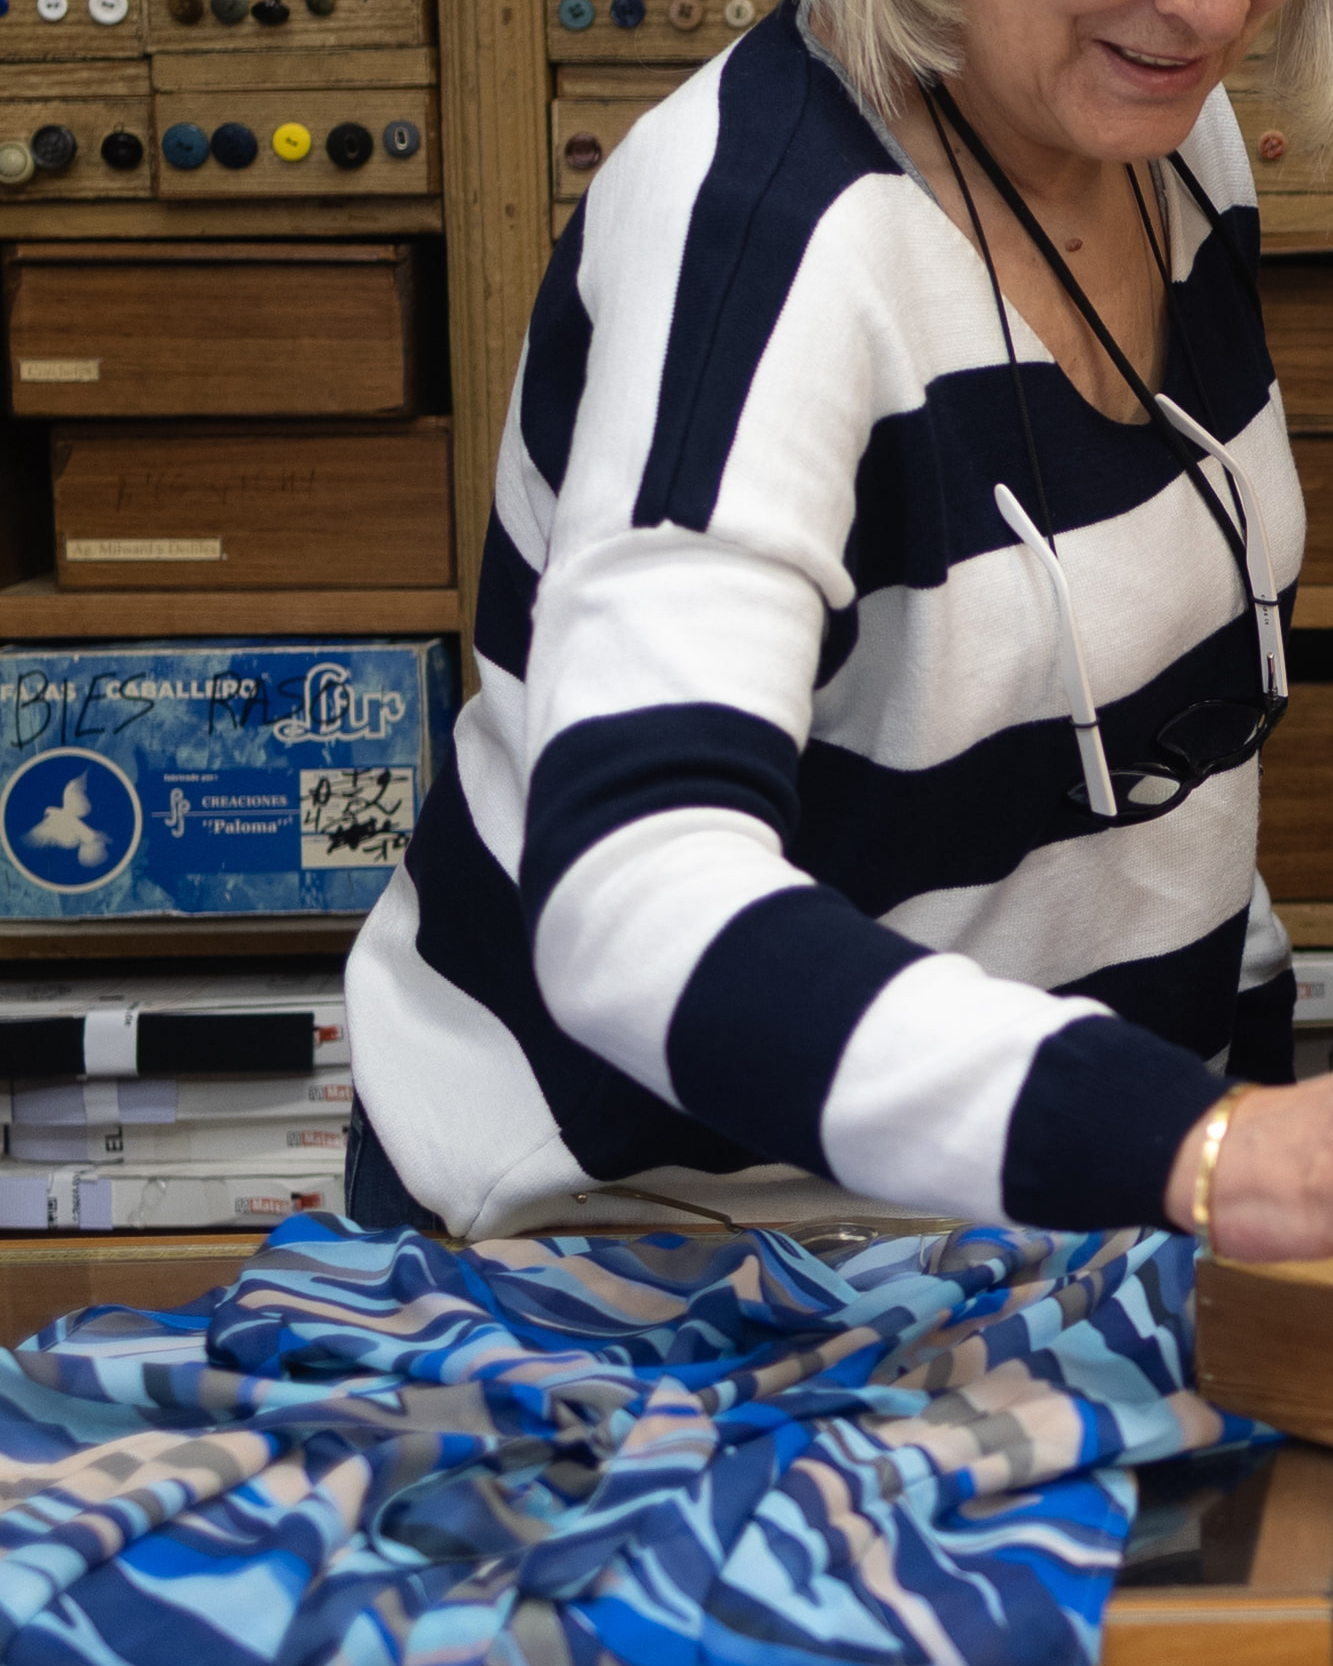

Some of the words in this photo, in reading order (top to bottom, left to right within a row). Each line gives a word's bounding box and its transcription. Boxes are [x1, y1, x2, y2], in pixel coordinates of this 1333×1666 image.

[106, 679, 257, 700] CABALLERO
[10, 670, 155, 750] BIES
[208, 672, 350, 736] RASO
[201, 795, 288, 808] CREACIONES
